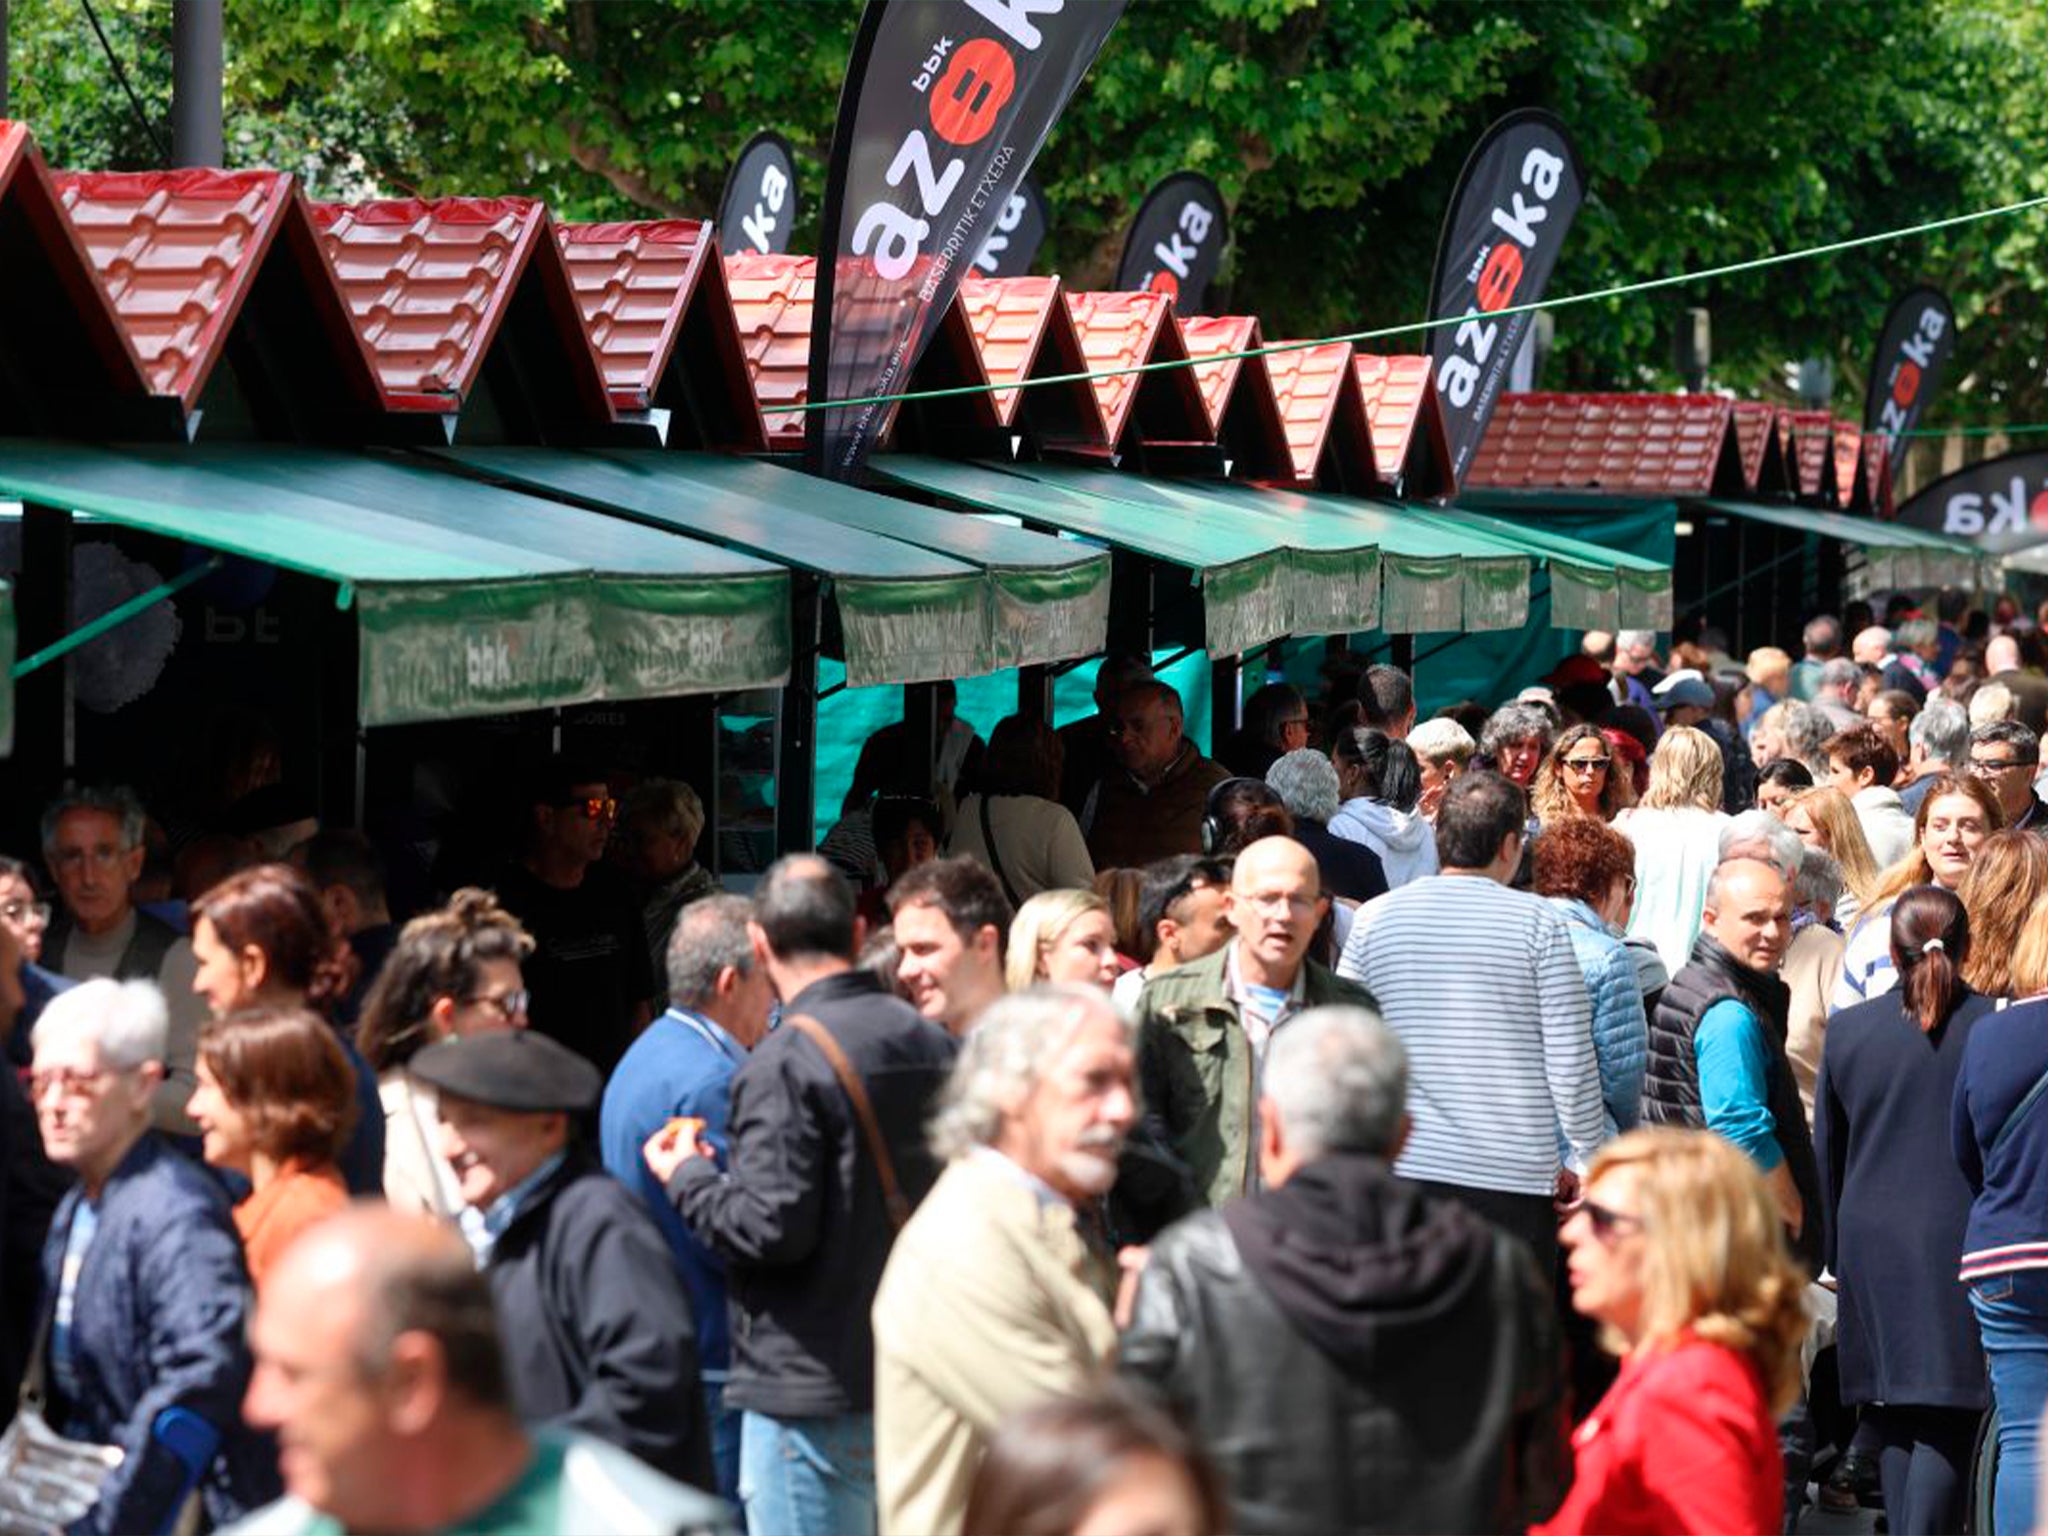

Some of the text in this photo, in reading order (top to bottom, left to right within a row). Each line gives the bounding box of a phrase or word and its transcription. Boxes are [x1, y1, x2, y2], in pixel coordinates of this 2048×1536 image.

[911, 36, 954, 93] bbk
[741, 164, 788, 256] ka
[970, 144, 1016, 210] ETXERA
